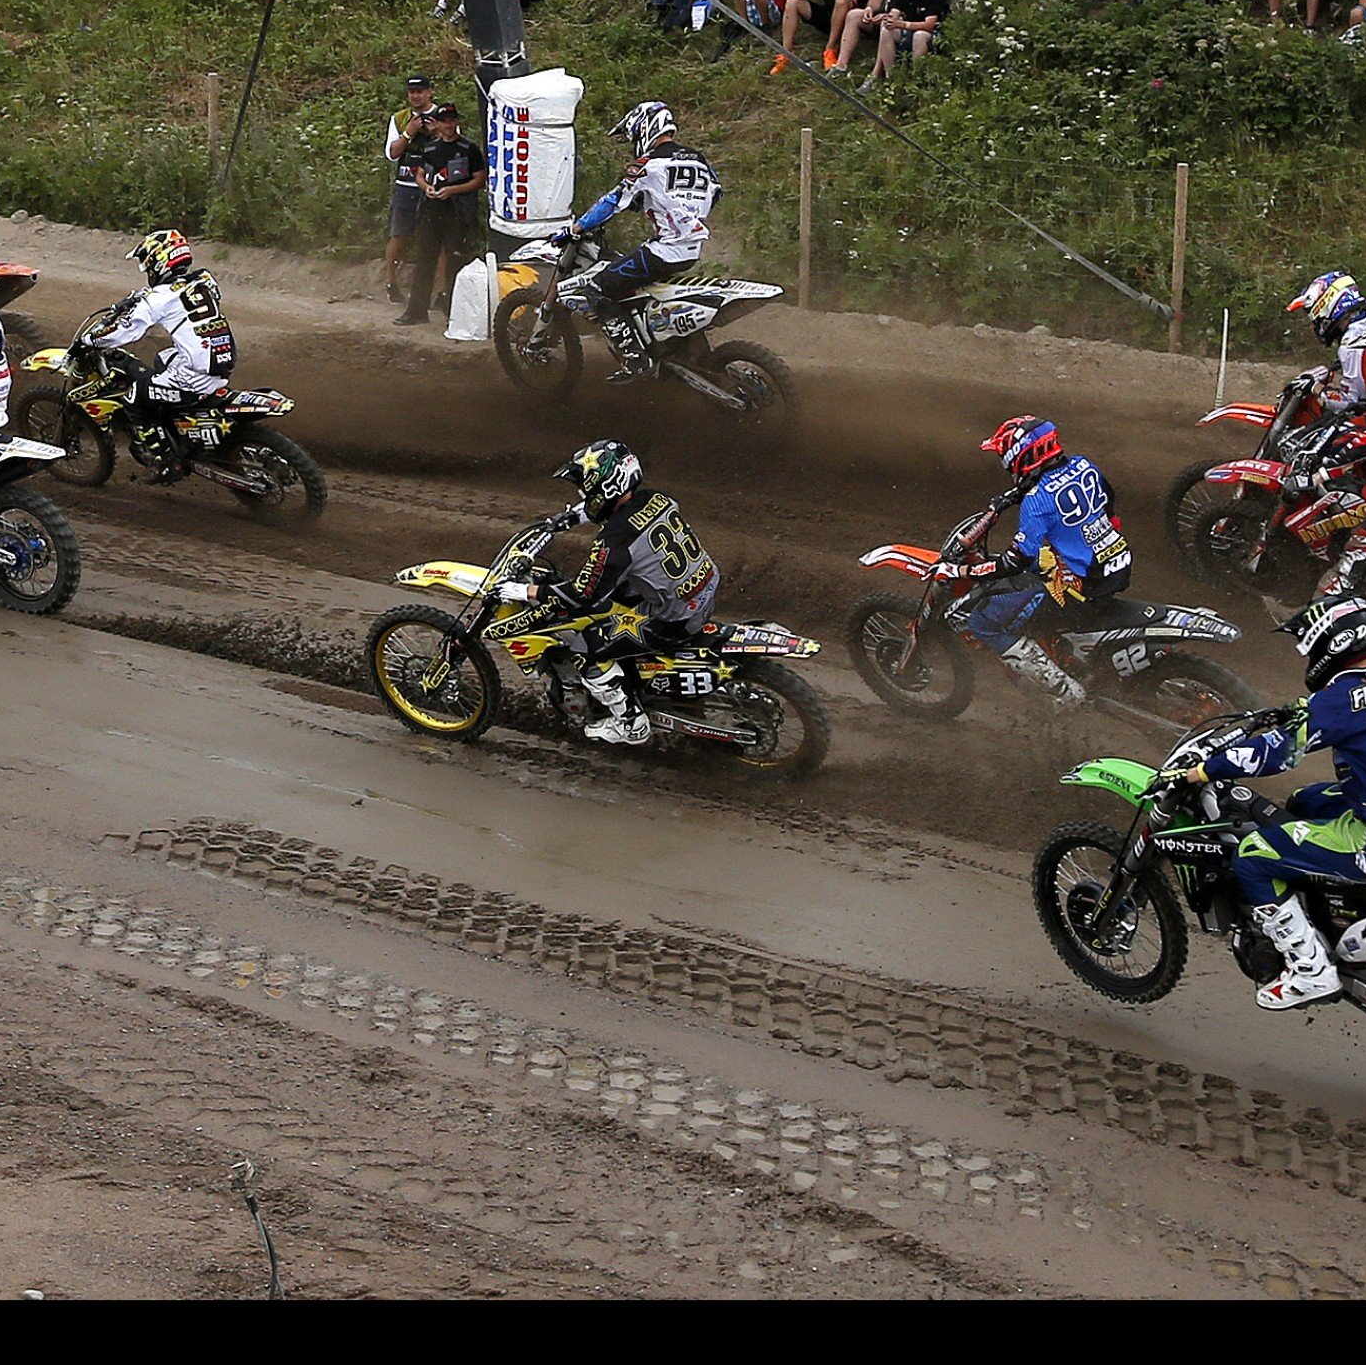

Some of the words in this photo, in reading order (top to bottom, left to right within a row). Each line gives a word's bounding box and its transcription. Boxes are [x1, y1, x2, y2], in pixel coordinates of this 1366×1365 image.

[665, 165, 708, 192] 195
[673, 310, 698, 334] 195
[200, 428, 221, 446] 91
[1055, 468, 1108, 526] 92
[648, 508, 703, 580] 33
[1103, 550, 1132, 577] KTM
[1111, 641, 1151, 677] 92
[679, 672, 713, 695] 33
[1153, 837, 1224, 856] MONSTER
